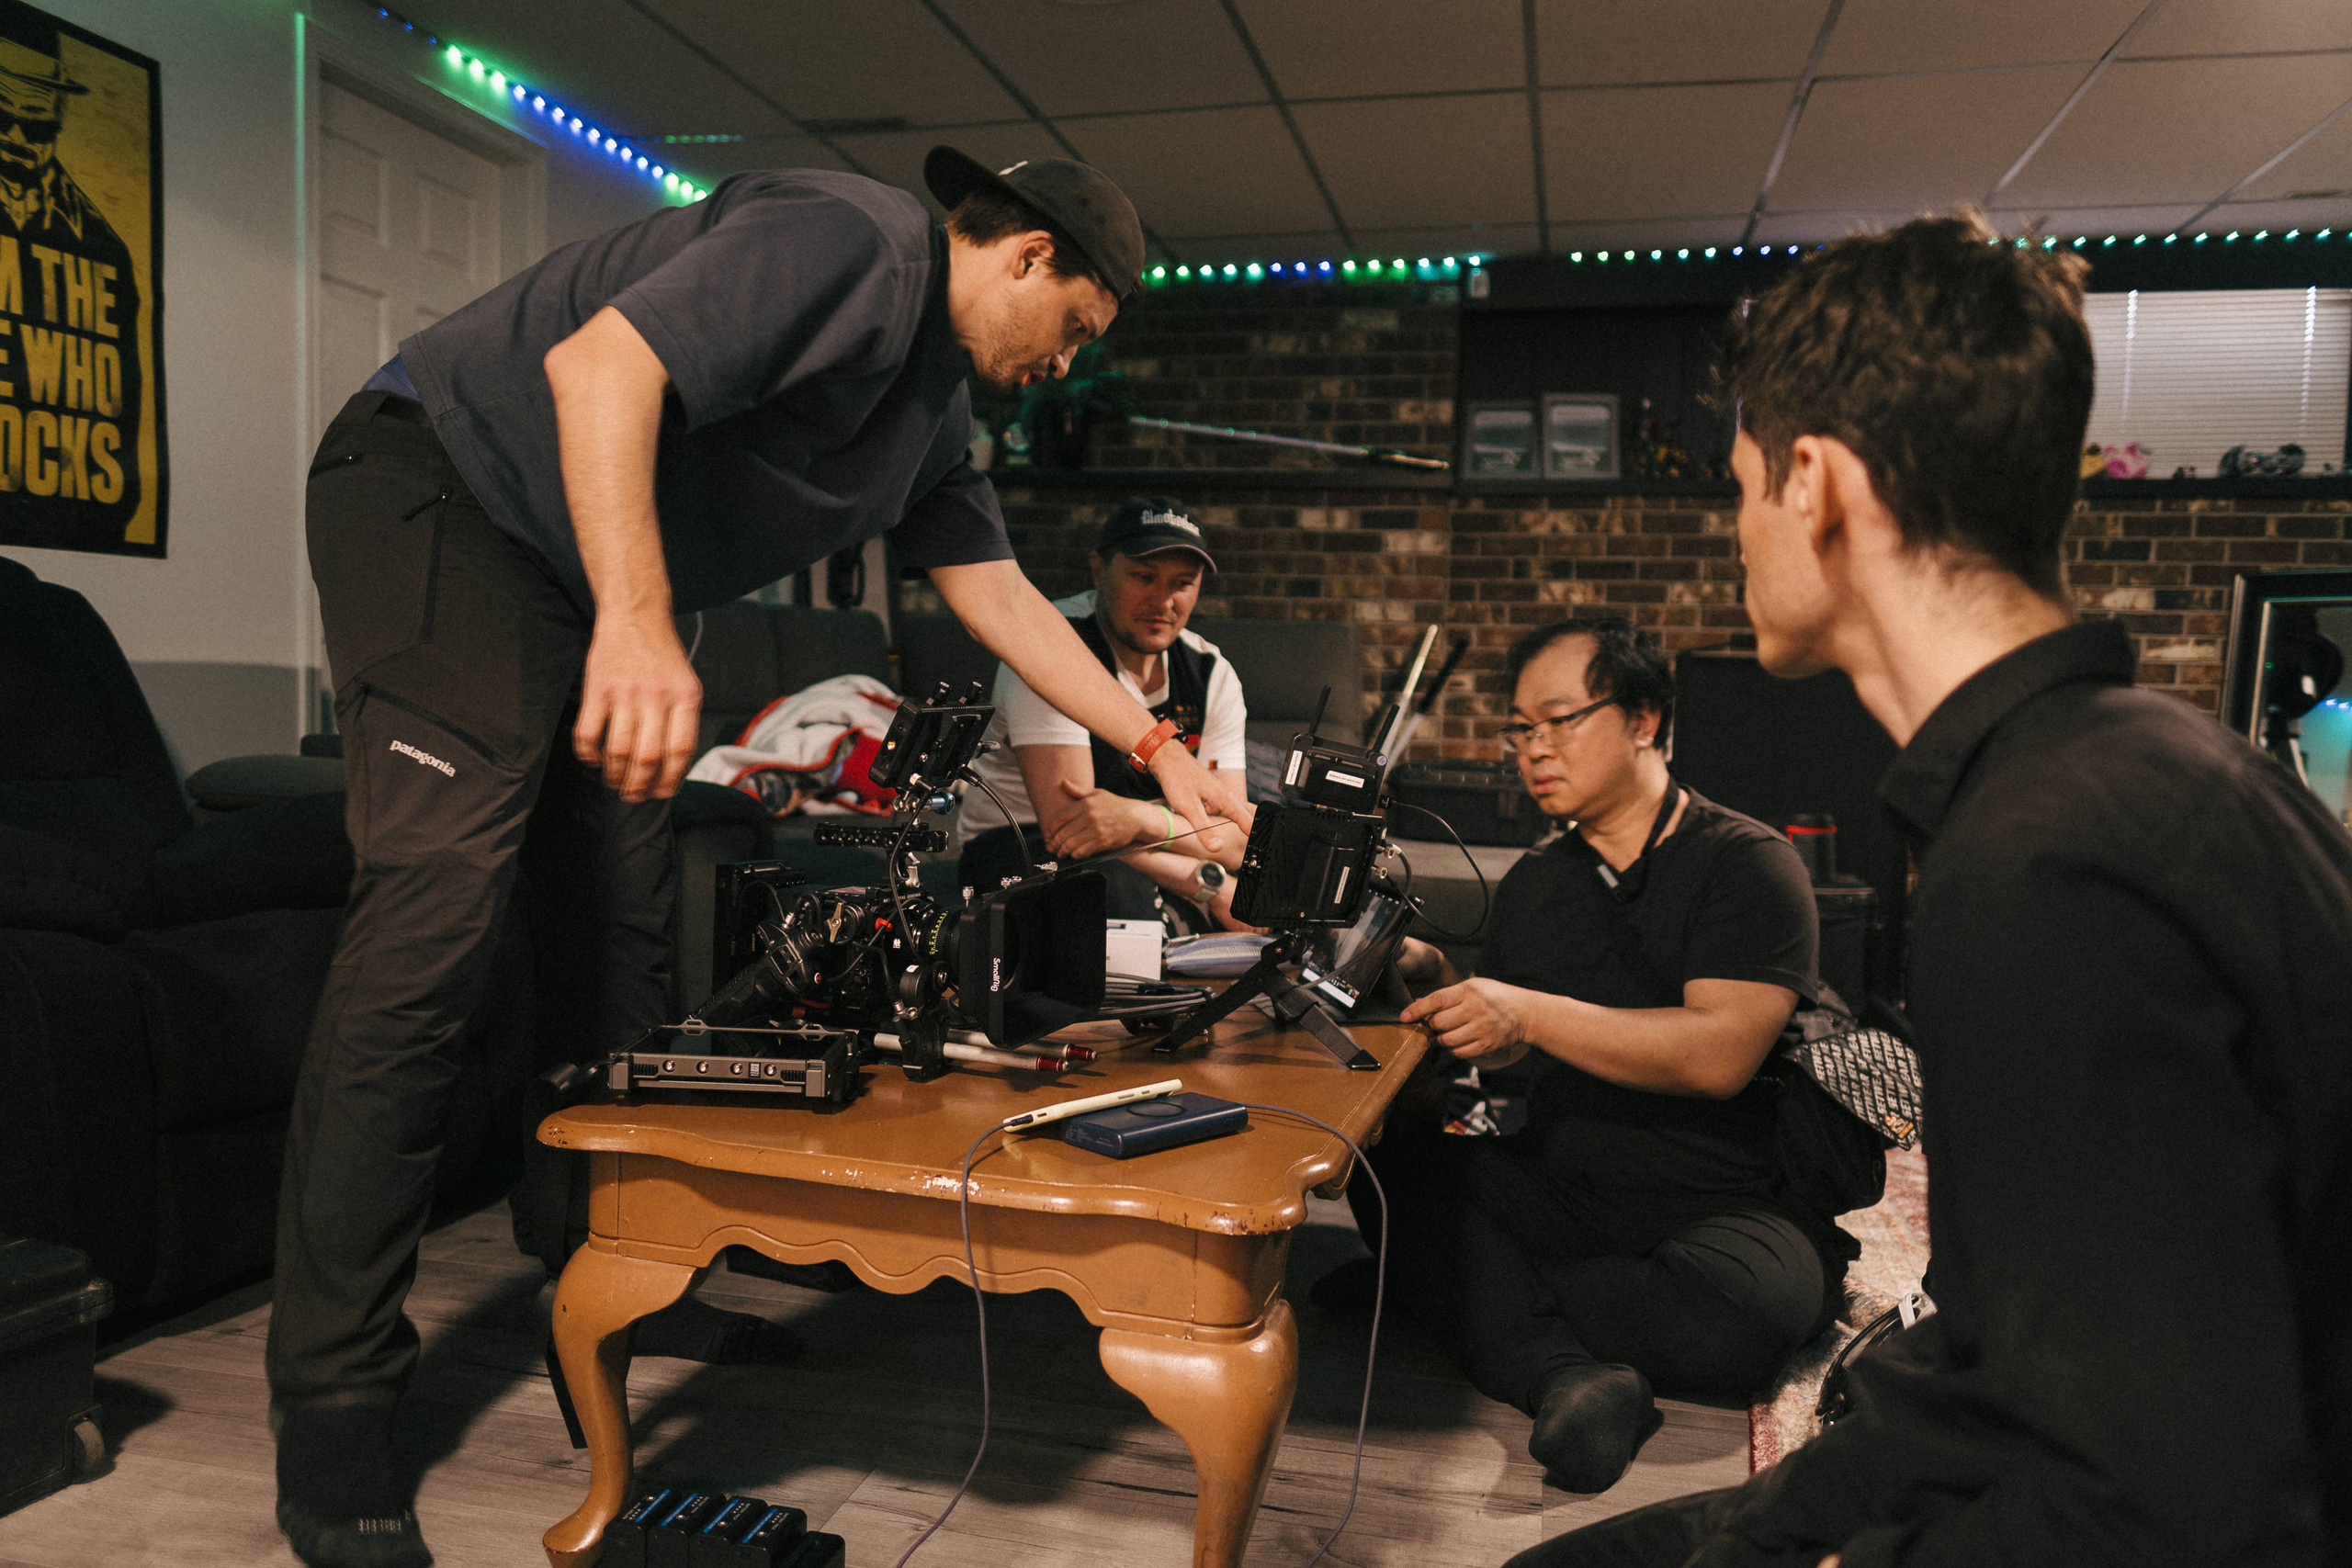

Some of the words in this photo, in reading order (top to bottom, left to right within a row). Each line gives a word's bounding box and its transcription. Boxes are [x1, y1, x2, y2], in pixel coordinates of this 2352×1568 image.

[31, 243, 119, 338] THE
[19, 323, 122, 417] WHO
[389, 739, 457, 778] patagonia
[990, 957, 1001, 992] SmallRig
